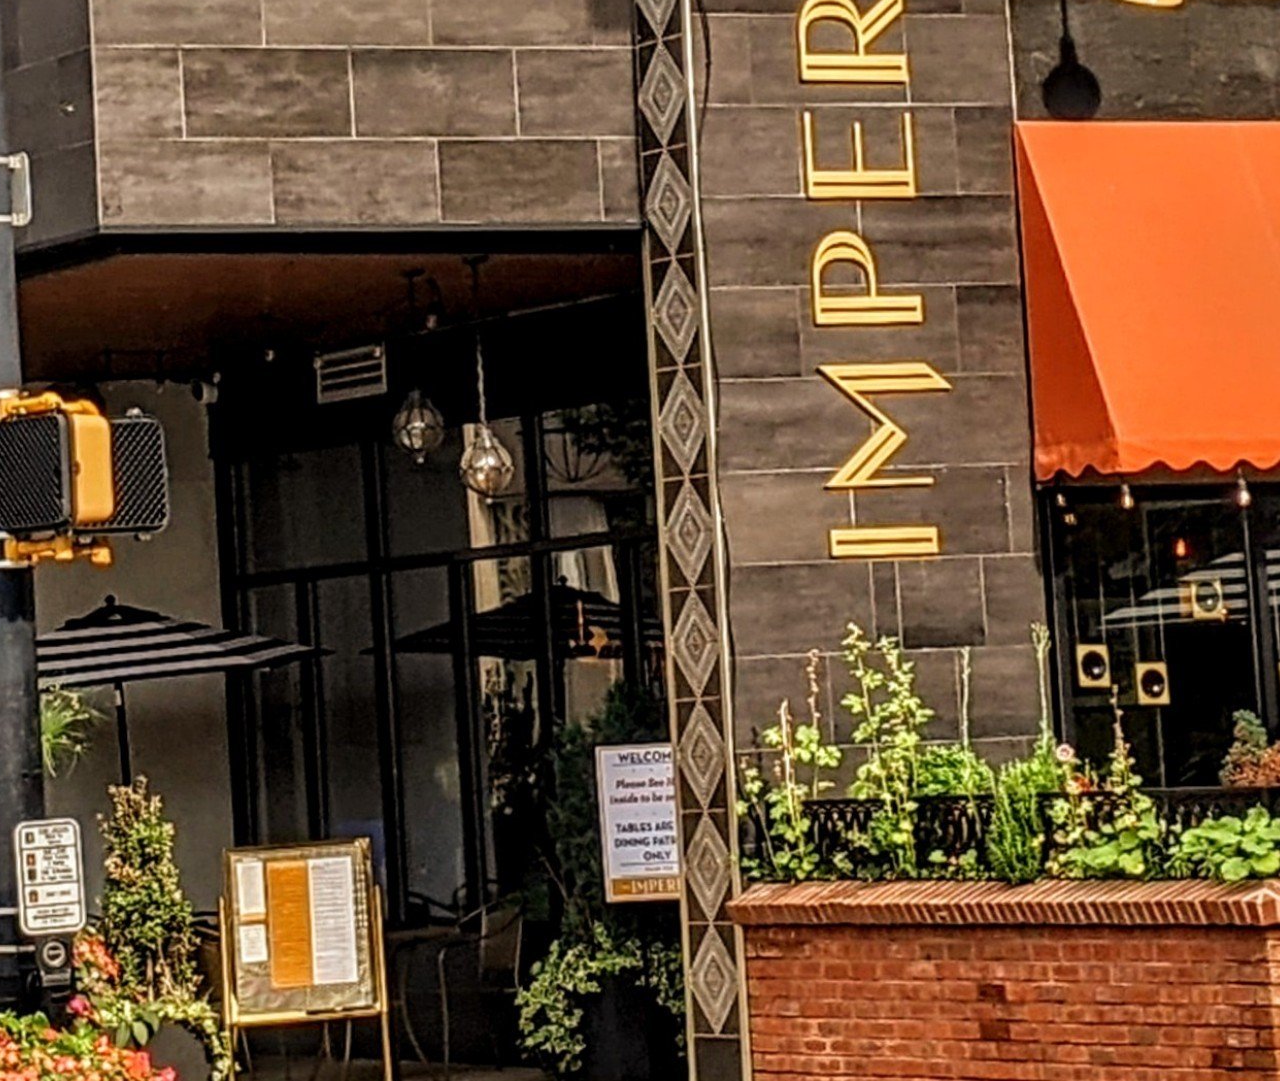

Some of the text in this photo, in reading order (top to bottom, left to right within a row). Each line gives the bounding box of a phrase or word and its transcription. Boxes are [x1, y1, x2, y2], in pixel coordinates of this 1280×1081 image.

[618, 751, 671, 763] WELCOM
[616, 823, 652, 833] TABLES
[614, 837, 650, 848] DINING
[643, 851, 671, 861] ONLY
